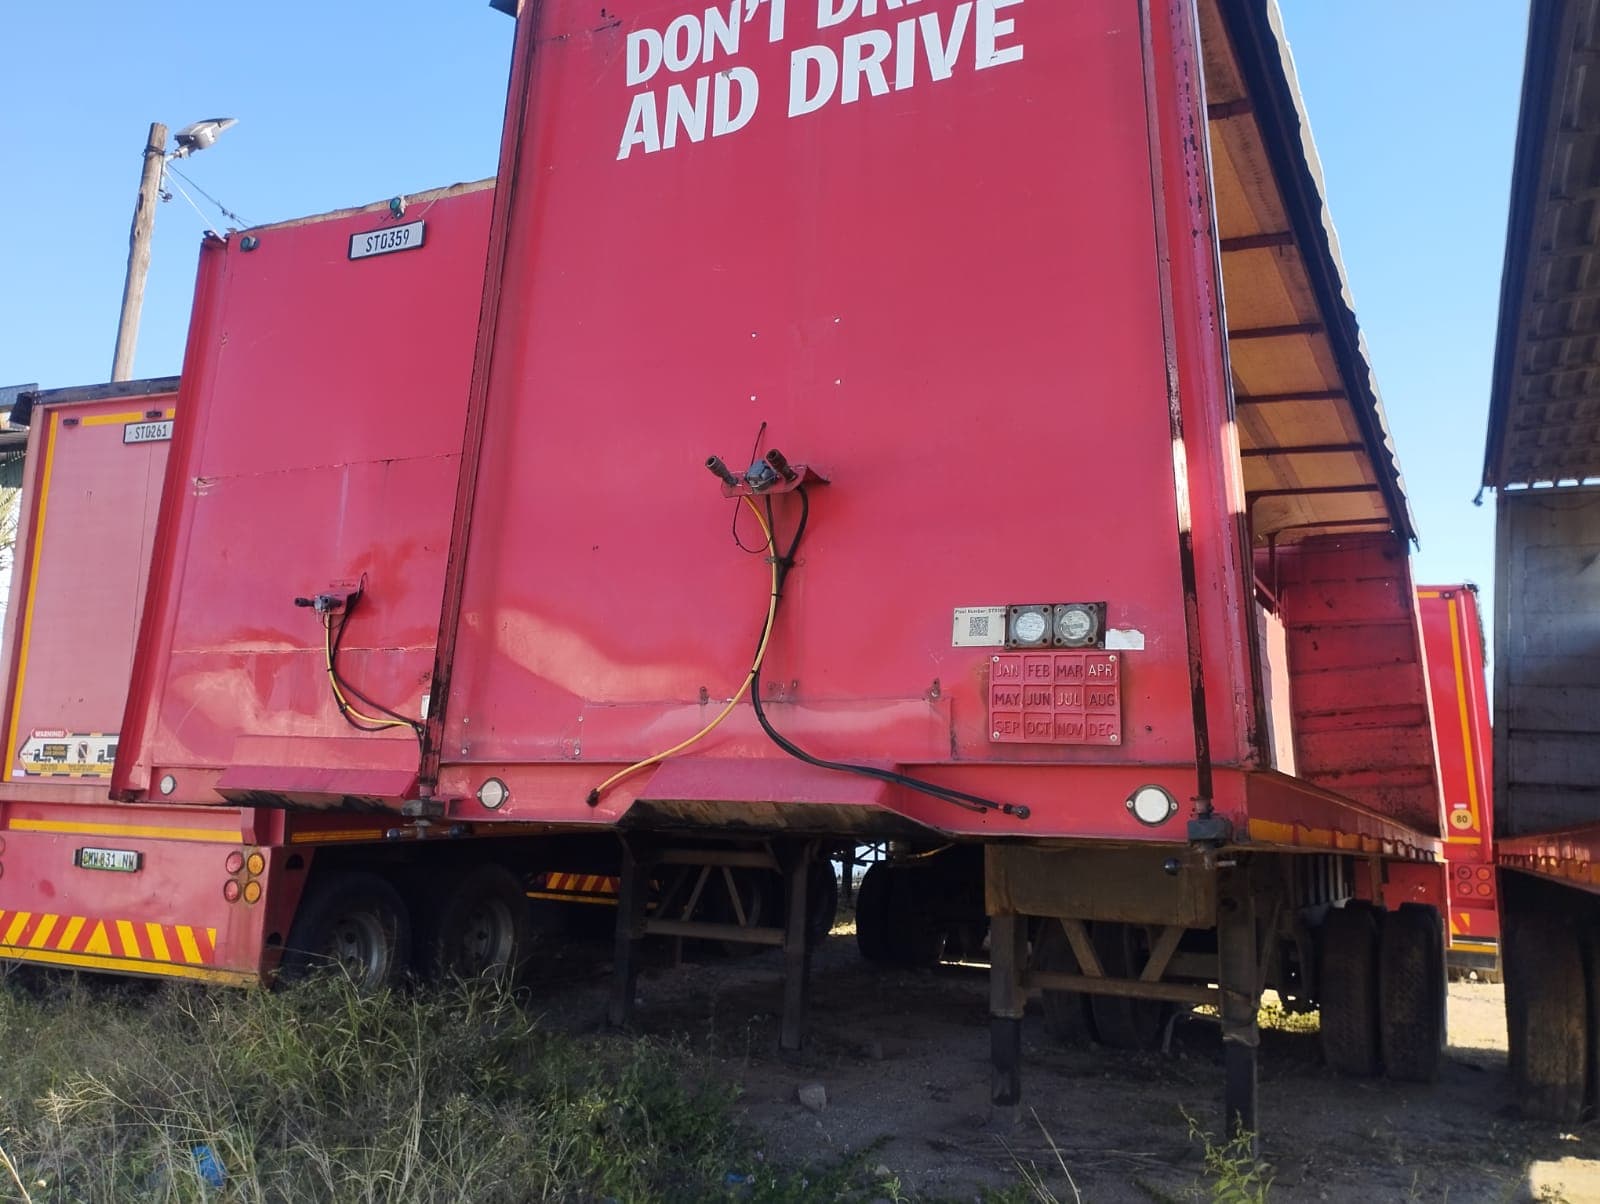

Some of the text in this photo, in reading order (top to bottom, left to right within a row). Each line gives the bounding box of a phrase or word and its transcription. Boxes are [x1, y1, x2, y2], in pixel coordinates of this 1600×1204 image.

[626, 0, 785, 87] DON'T
[616, 0, 1025, 161] AND DRIVE
[996, 664, 1113, 678] JAN FEB MAR APR
[995, 692, 1115, 706] MAY JUN JUL AUG
[996, 720, 1114, 736] SEP OCT NOV DEC
[1456, 815, 1468, 824] 80
